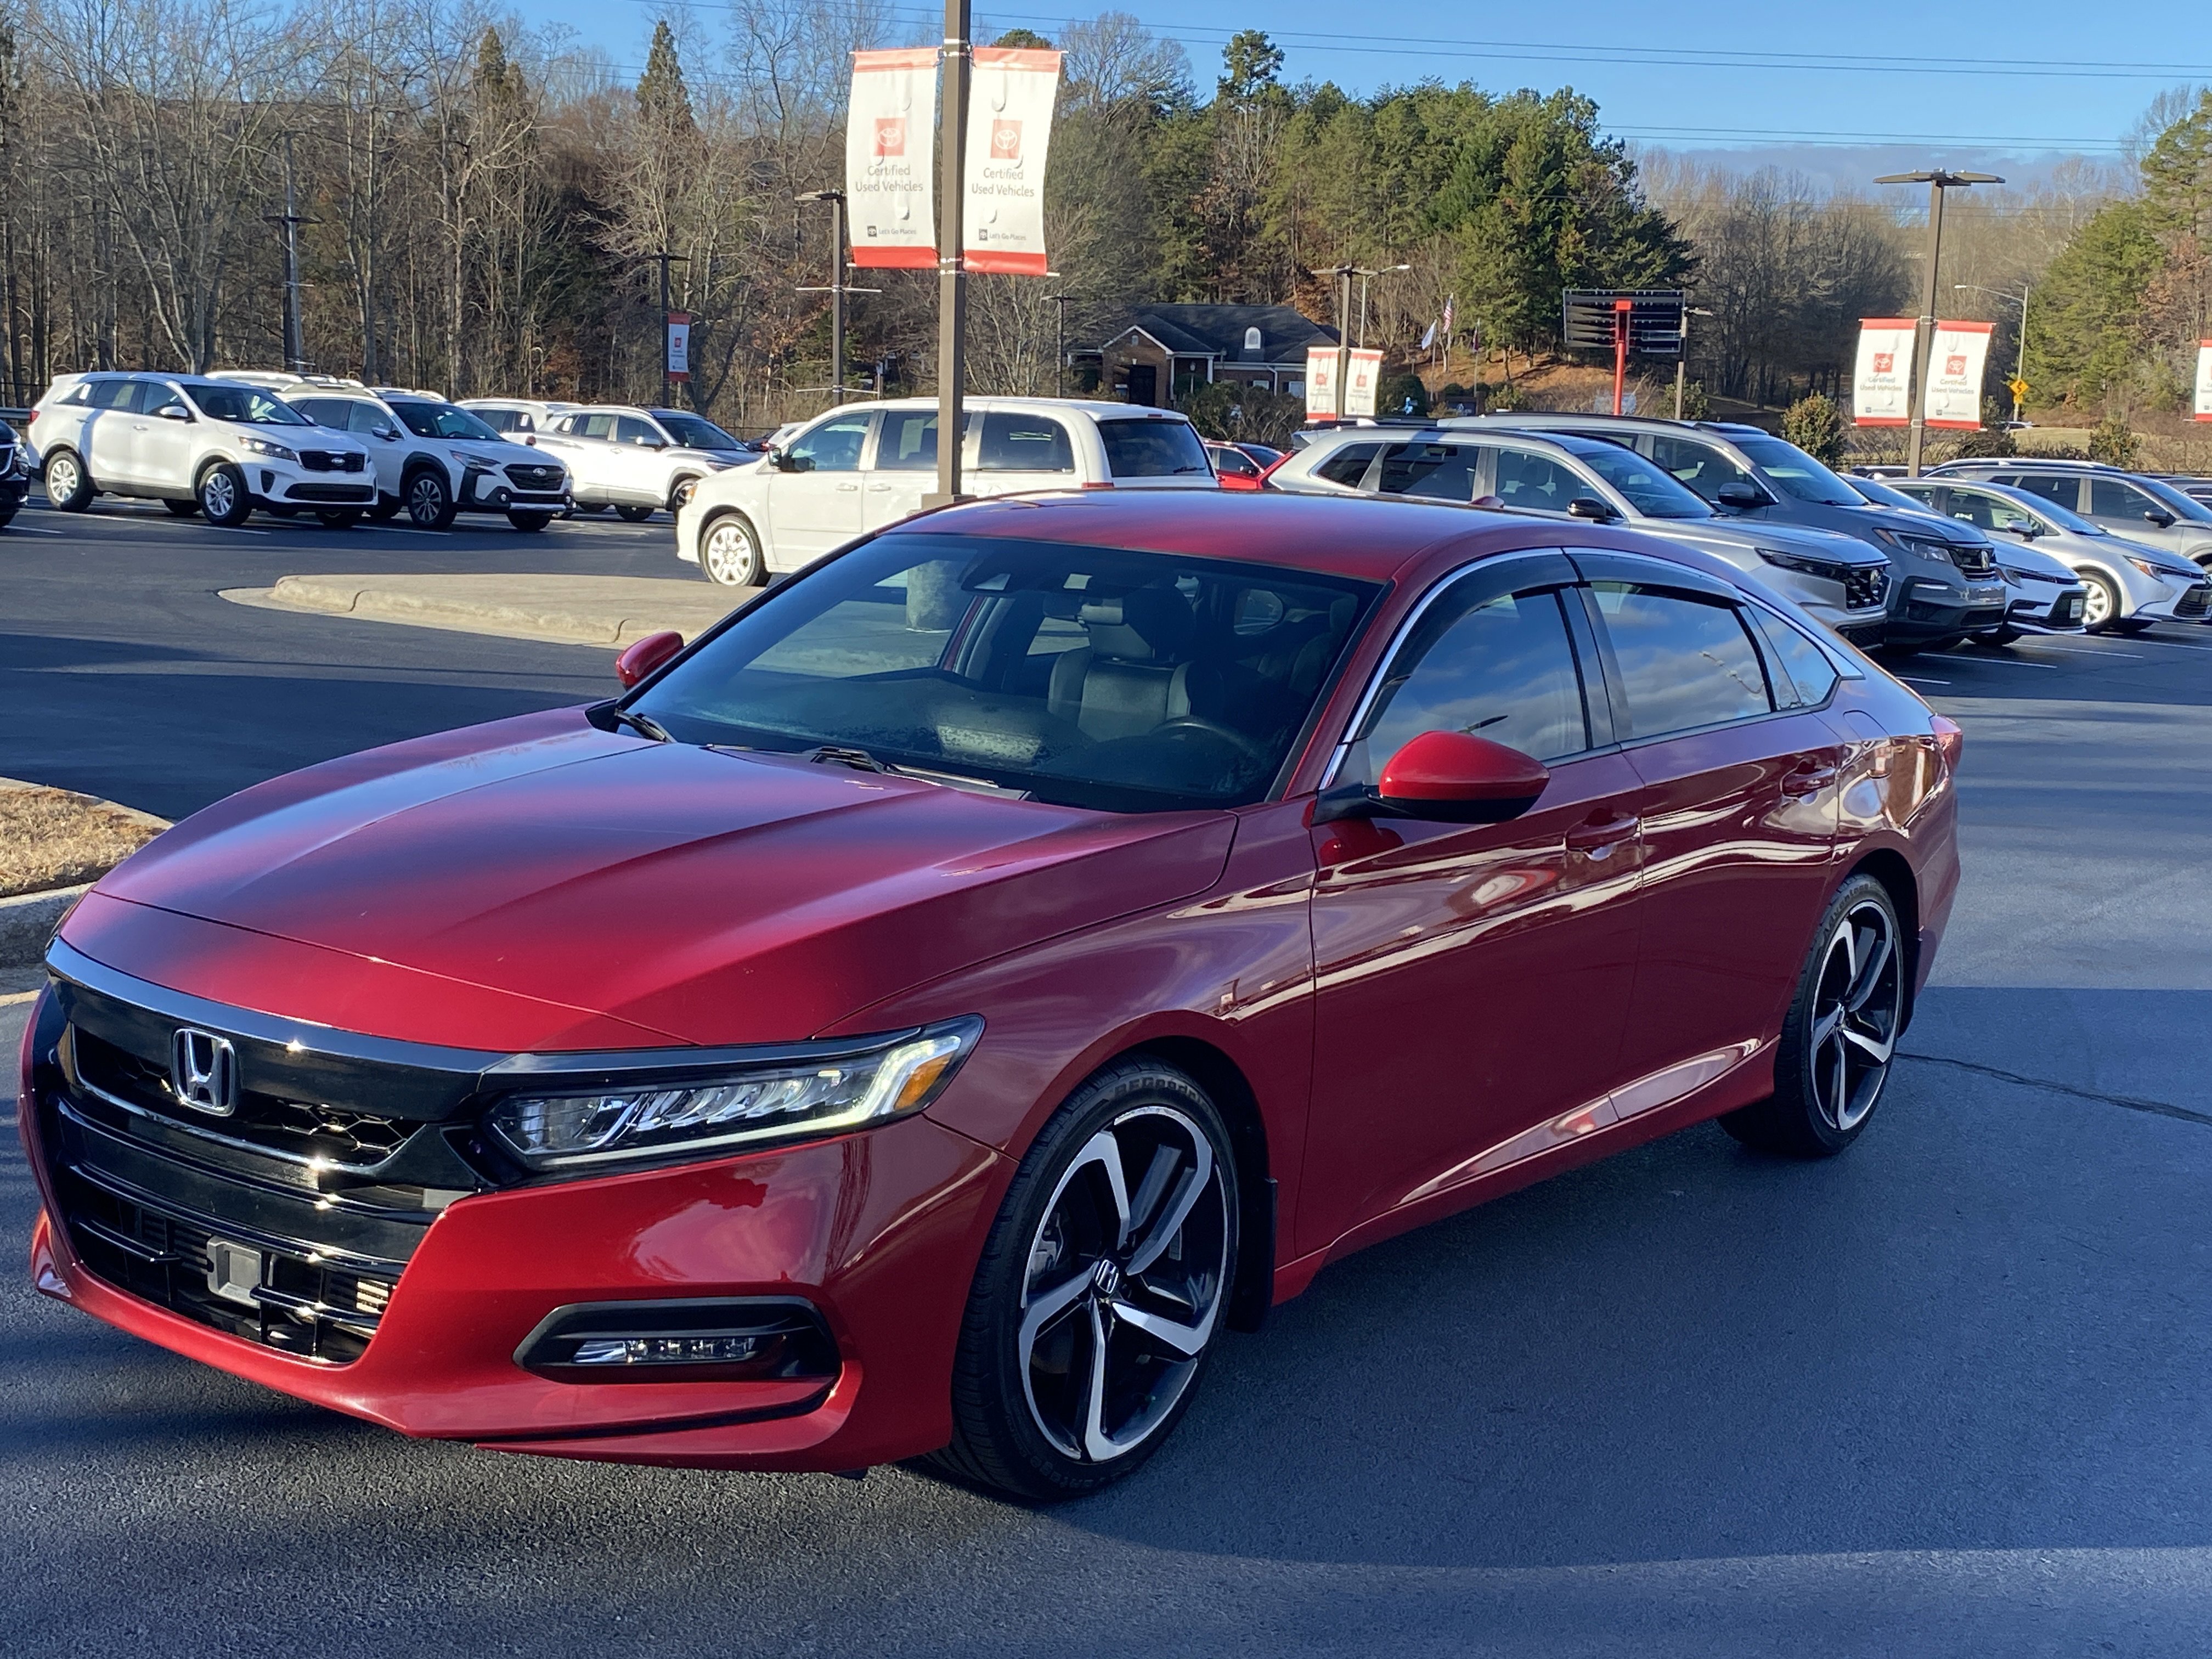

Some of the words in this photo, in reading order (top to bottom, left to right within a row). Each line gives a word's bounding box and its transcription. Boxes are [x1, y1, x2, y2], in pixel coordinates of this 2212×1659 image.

[867, 164, 911, 176] Certified
[983, 167, 1024, 180] Certified
[855, 180, 880, 192] Used
[882, 180, 923, 192] Vehicles
[972, 183, 994, 195] Used
[996, 184, 1035, 198] Vehicles
[1114, 1077, 1215, 1118] BFGoodri
